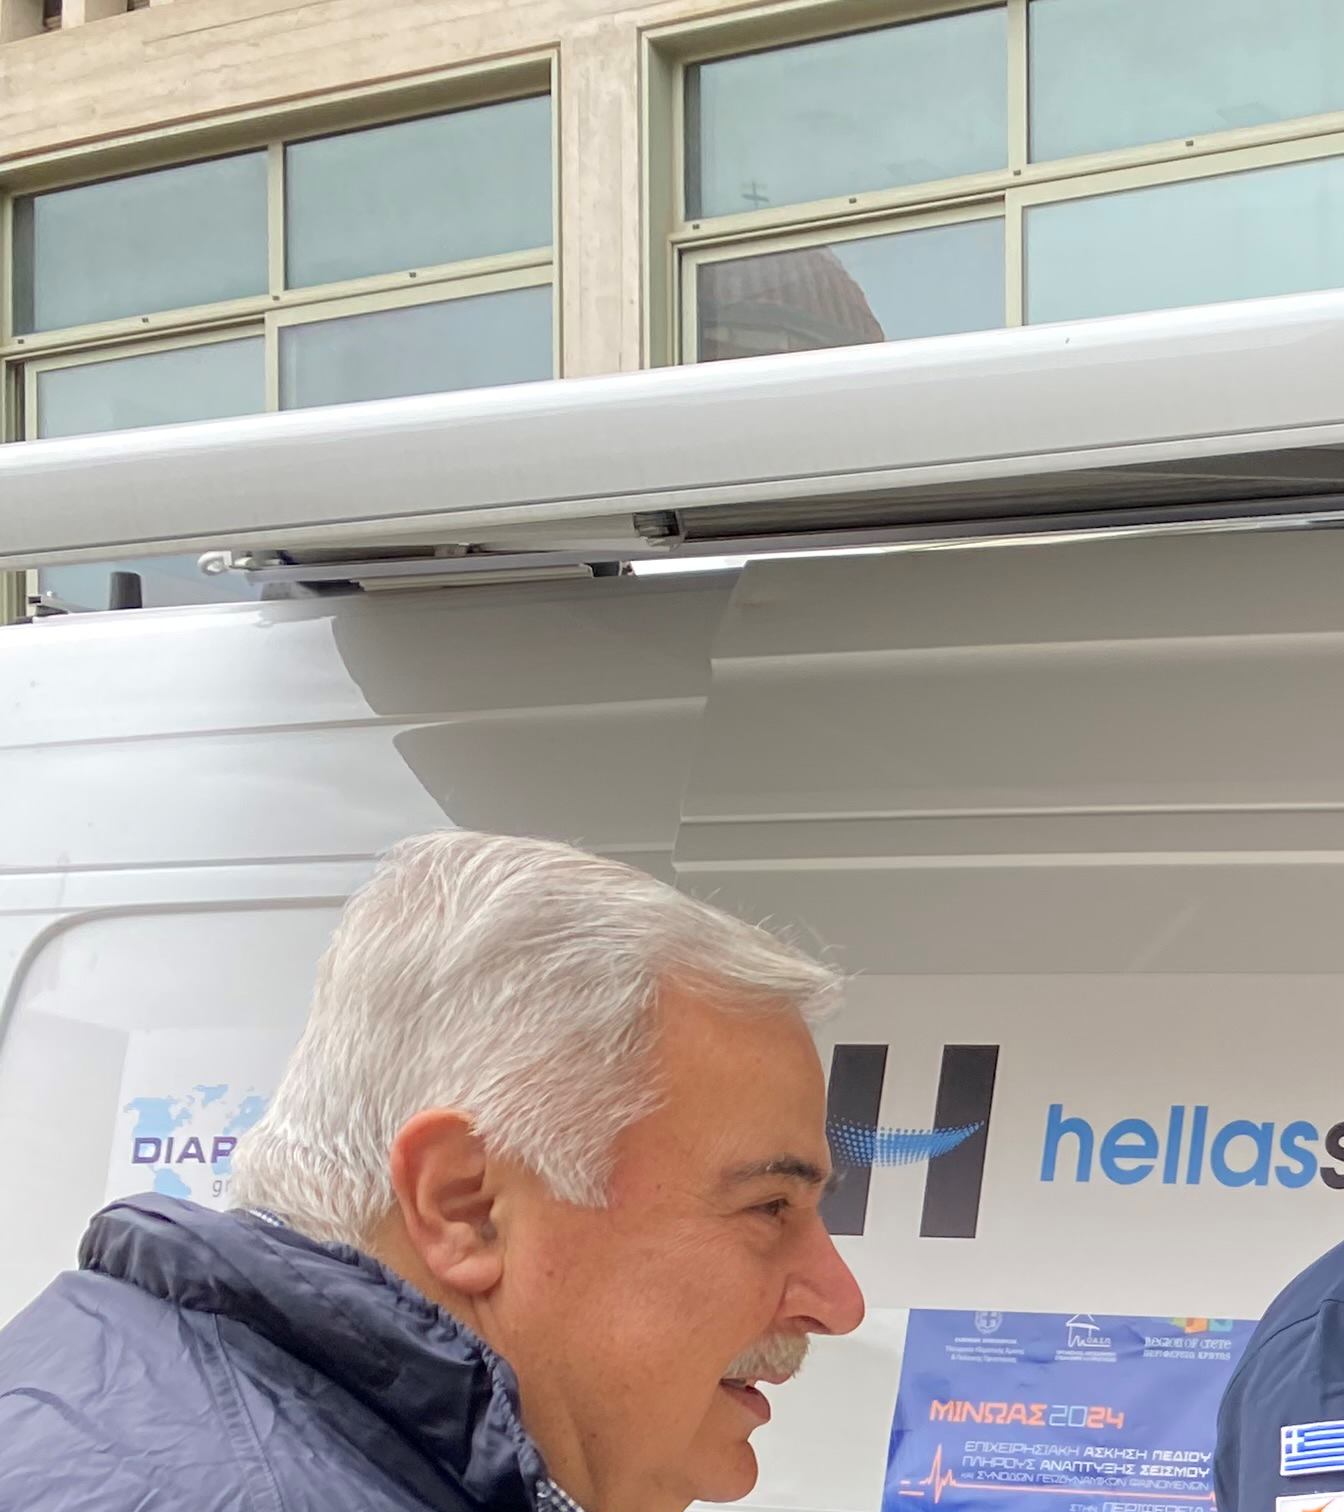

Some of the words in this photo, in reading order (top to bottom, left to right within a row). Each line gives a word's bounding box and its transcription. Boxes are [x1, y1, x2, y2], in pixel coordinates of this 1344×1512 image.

[964, 1440, 1079, 1457] ΕΠΙΧΕΙΡΗΣΙΑΚΗ
[1083, 1446, 1148, 1460] ΑΣΚΗΣΗ
[1152, 1449, 1212, 1463] ΠΕΔΙΟΥ
[962, 1455, 1036, 1471] ΠΛΗΡΟΥΣ
[1040, 1459, 1137, 1475] ΑΝΑΠΤΥΞΗΣ
[1139, 1464, 1211, 1478] ΣΕΙΣΜΟΥ
